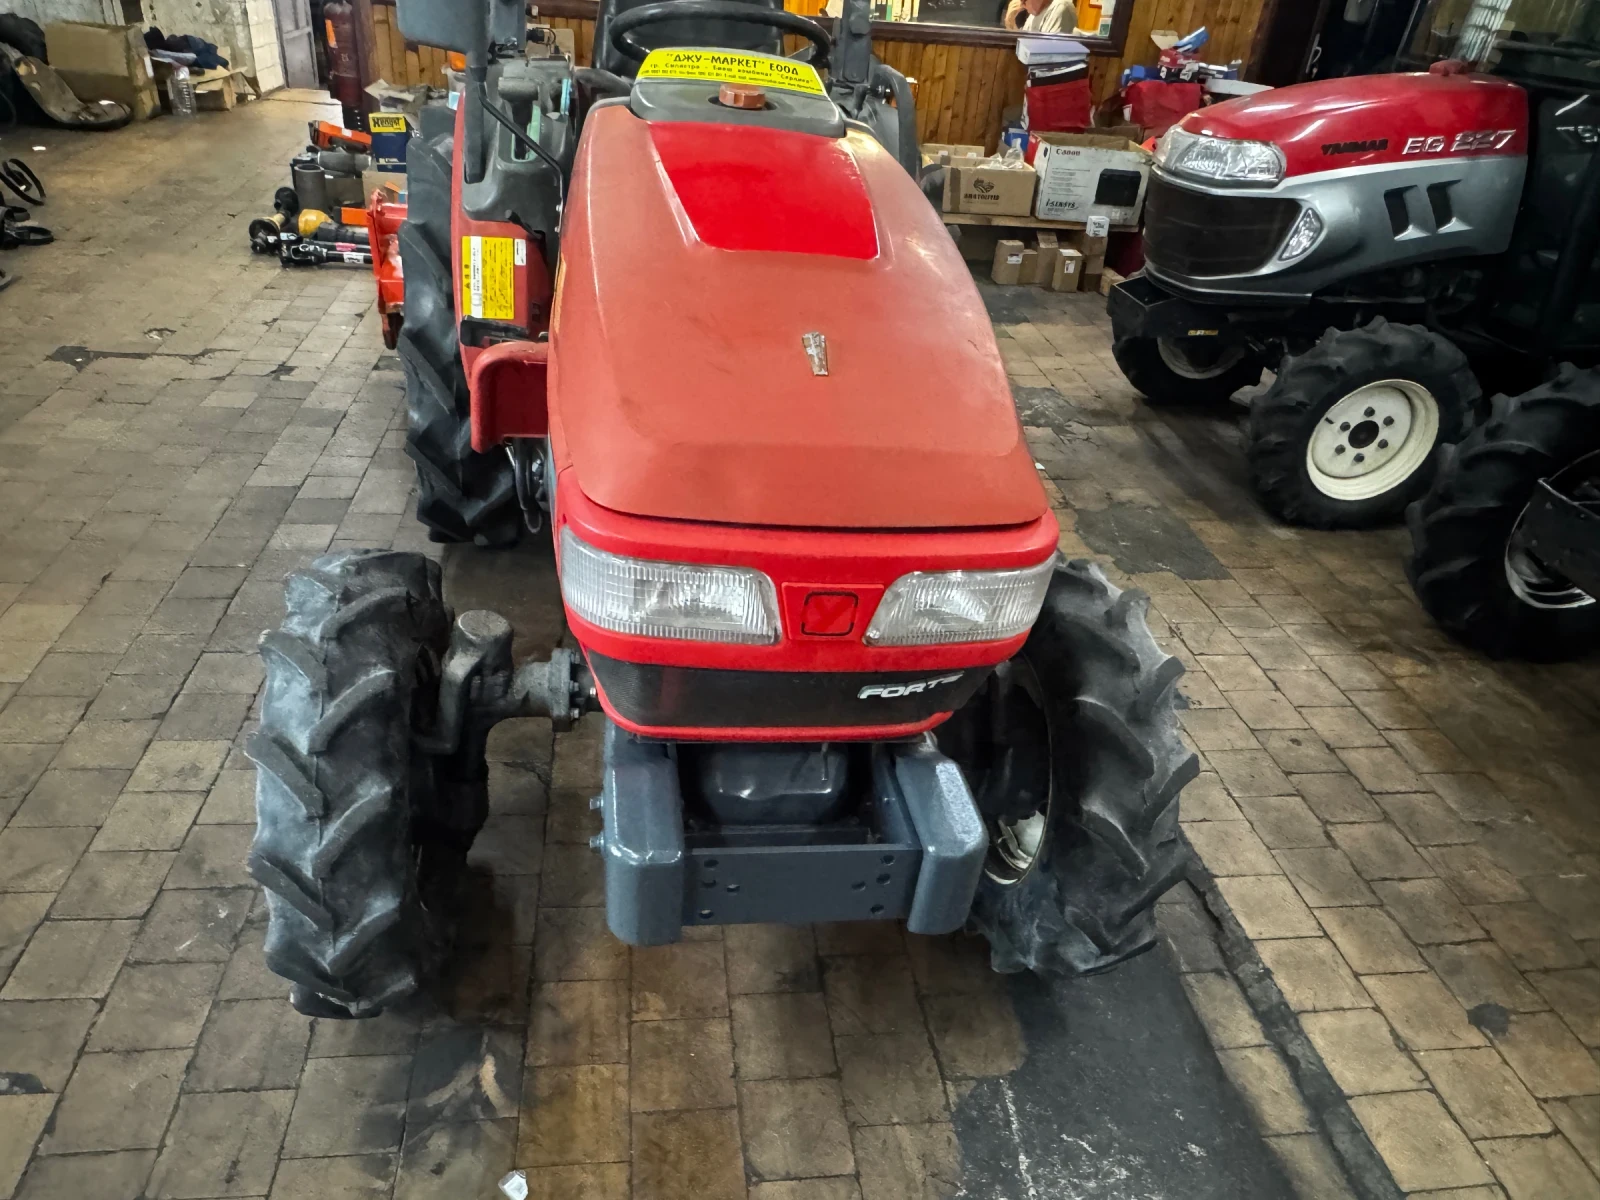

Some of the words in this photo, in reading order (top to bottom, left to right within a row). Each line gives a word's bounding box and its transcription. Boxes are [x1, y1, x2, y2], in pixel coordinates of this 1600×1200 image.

[769, 62, 799, 76] ЕООД
[1402, 136, 1444, 155] EG
[1450, 129, 1516, 152] 227
[1056, 148, 1080, 156] Canon
